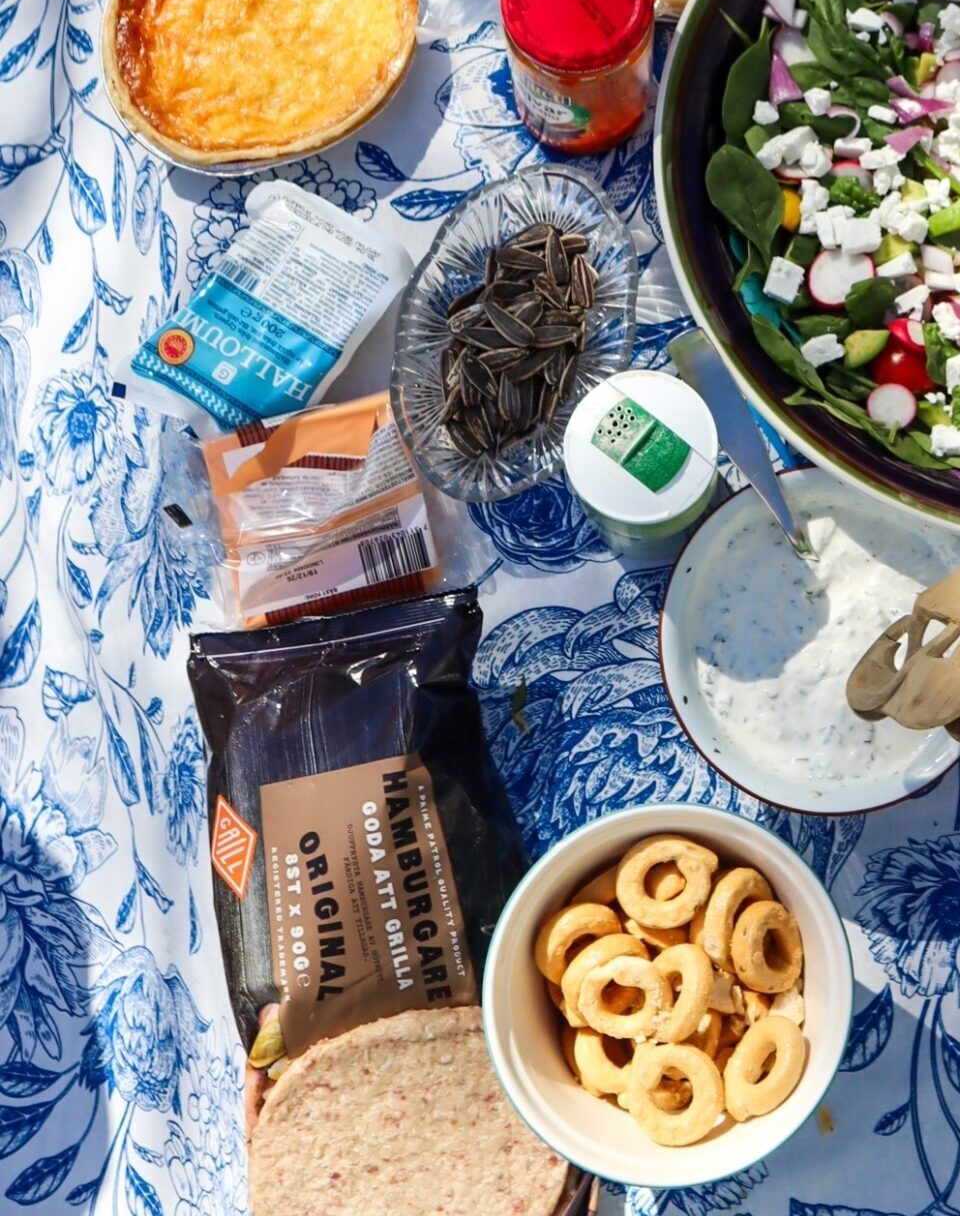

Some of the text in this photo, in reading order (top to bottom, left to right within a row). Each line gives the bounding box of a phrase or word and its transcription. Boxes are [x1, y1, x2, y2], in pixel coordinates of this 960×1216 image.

[216, 817, 247, 874] GRILL
[271, 846, 292, 1003] REGISTERED TRADEMARK
[285, 853, 301, 895] 8ST
[299, 831, 346, 1002] ORIGINAL
[351, 897, 359, 913] ATT
[361, 801, 414, 990] GODA ATT GRILLA
[382, 770, 452, 1003] HAMBURGARE
[419, 794, 432, 830] PRIME
[427, 833, 443, 875] PATROL
[438, 878, 455, 927] QUALITY
[449, 931, 466, 977] PRODUCT
